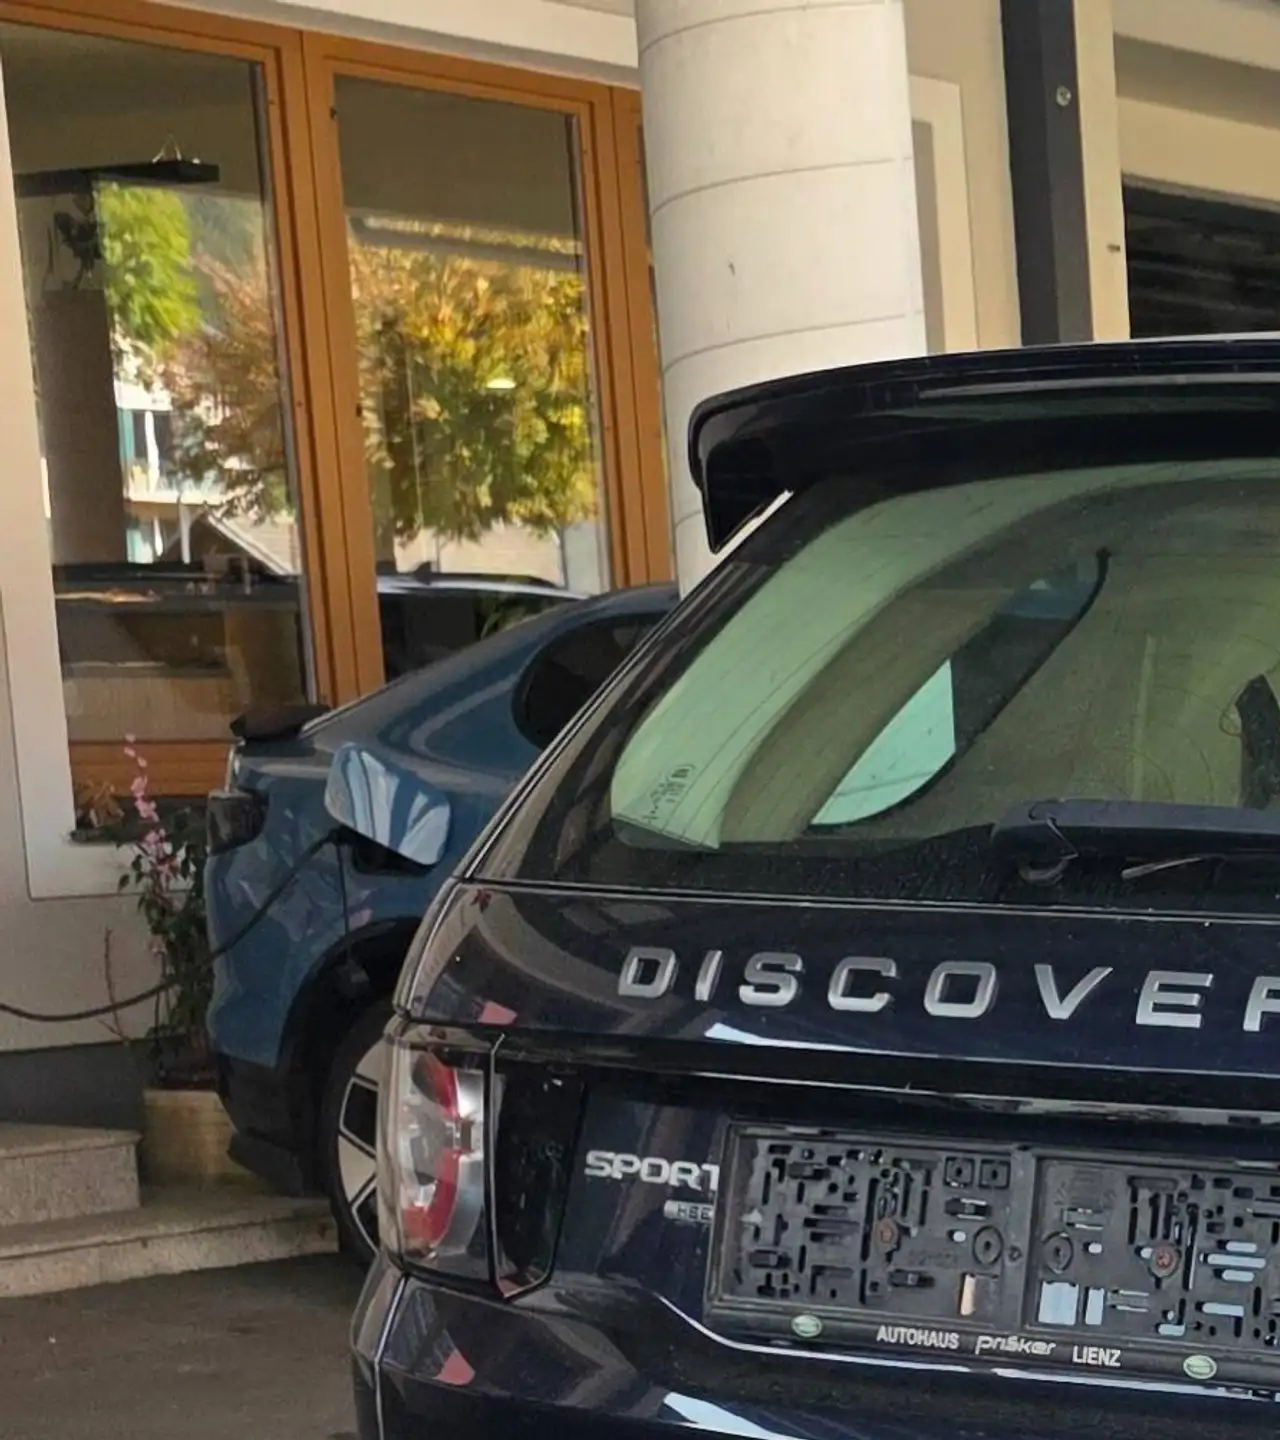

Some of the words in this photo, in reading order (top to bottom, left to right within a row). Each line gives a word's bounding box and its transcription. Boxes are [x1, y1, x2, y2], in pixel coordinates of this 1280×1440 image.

[584, 1150, 720, 1192] SPORT
[876, 1325, 960, 1350] AUTOHAUS
[1072, 1345, 1121, 1367] LIENZ
